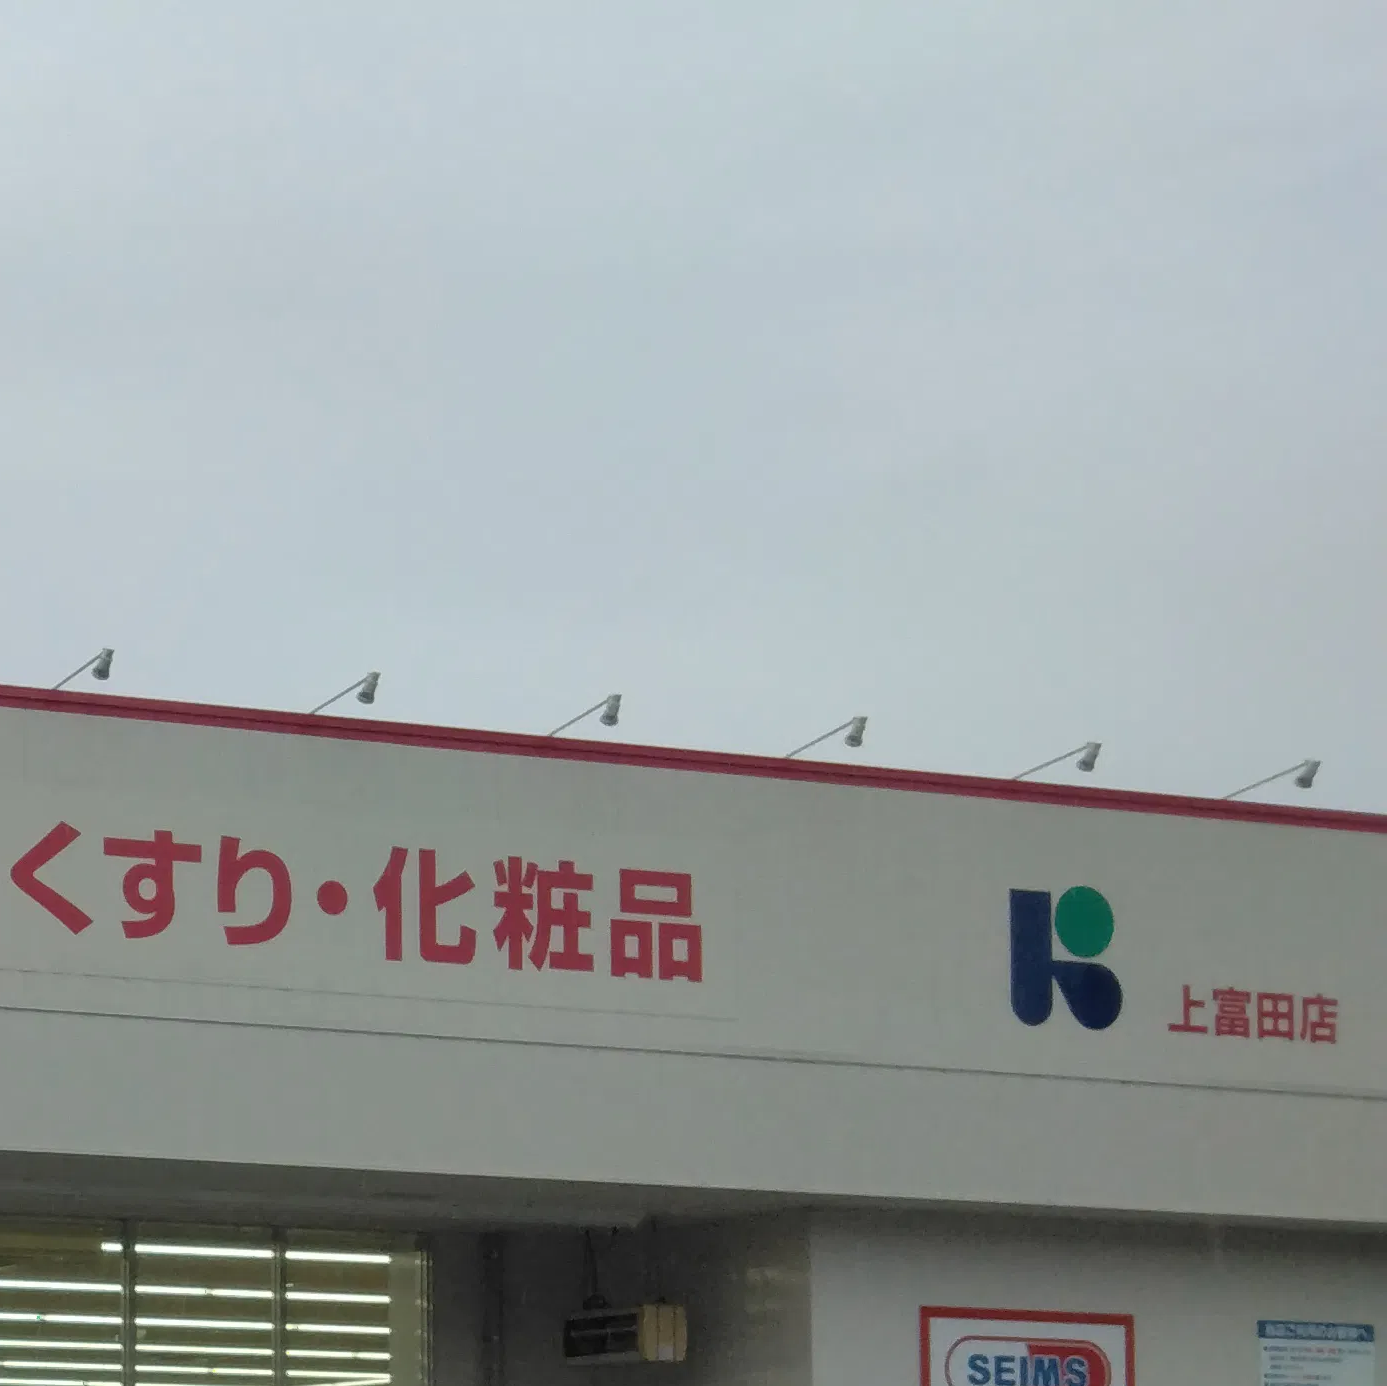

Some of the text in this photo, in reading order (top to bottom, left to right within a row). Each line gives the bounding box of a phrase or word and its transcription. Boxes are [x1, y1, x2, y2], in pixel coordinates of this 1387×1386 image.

[10, 820, 704, 982] くすり・化粧品
[1167, 984, 1339, 1045] 上富田店
